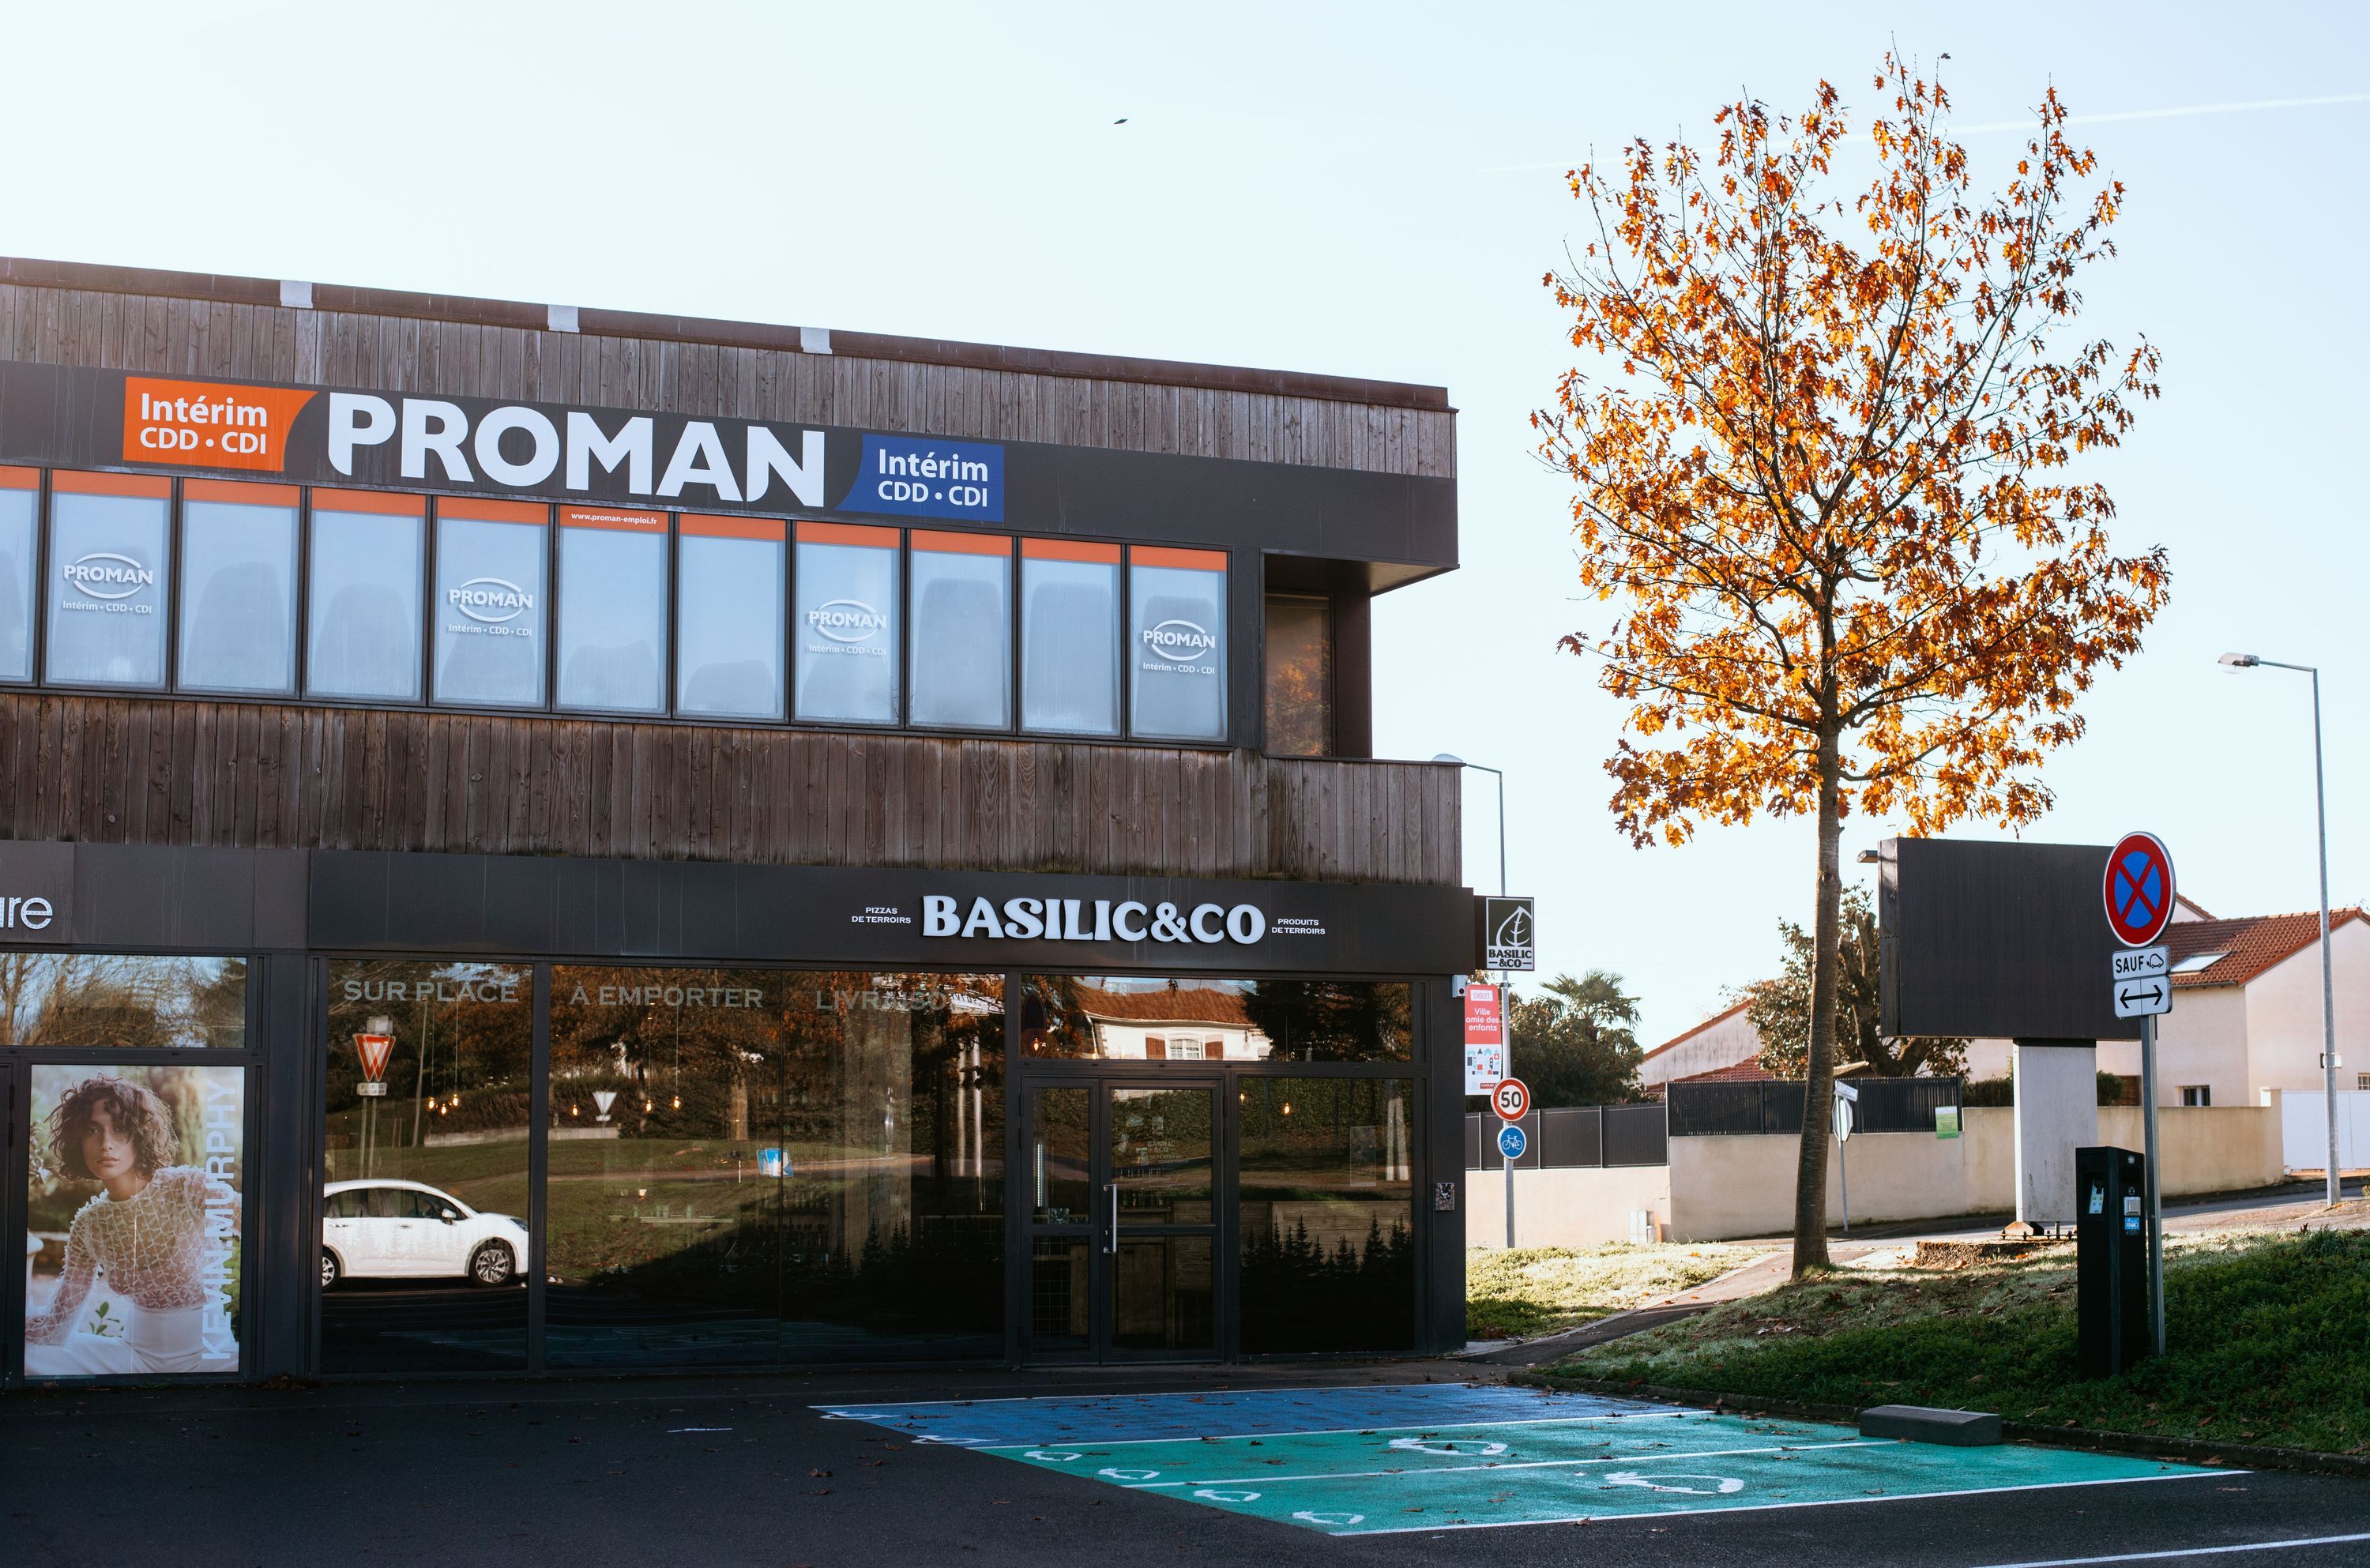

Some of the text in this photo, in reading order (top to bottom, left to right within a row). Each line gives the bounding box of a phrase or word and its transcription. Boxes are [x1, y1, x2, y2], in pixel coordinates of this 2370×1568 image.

[141, 393, 267, 427] Intérim
[140, 427, 266, 454] CDD CDI
[328, 391, 825, 508] PROMAN
[879, 449, 988, 482] Intérim
[878, 480, 988, 507] CDD CDI
[571, 513, 657, 525] www.proman-emploi.fr
[63, 565, 153, 585] PROMAN
[62, 600, 152, 614] Intérim CDD CDI
[450, 588, 533, 608] PROMAN
[808, 611, 887, 629] PROMAN
[449, 623, 532, 637] Intérim CDD CDI
[1143, 630, 1216, 649] PROMAN
[809, 644, 840, 653] Intérim
[846, 645, 866, 655] CDD
[1143, 662, 1172, 671] Intérim
[1201, 667, 1215, 675] CDI
[922, 894, 1266, 945] BASILIC&CO
[1488, 949, 1533, 959] BASILIC
[1499, 958, 1522, 968] &CO
[2116, 956, 2144, 973] SAUF
[343, 980, 519, 1003] SUR PLACE
[568, 980, 764, 1009] À EMPORTER
[1501, 1091, 1522, 1108] 50
[201, 1078, 236, 1360] KEVIN.MURPHY
